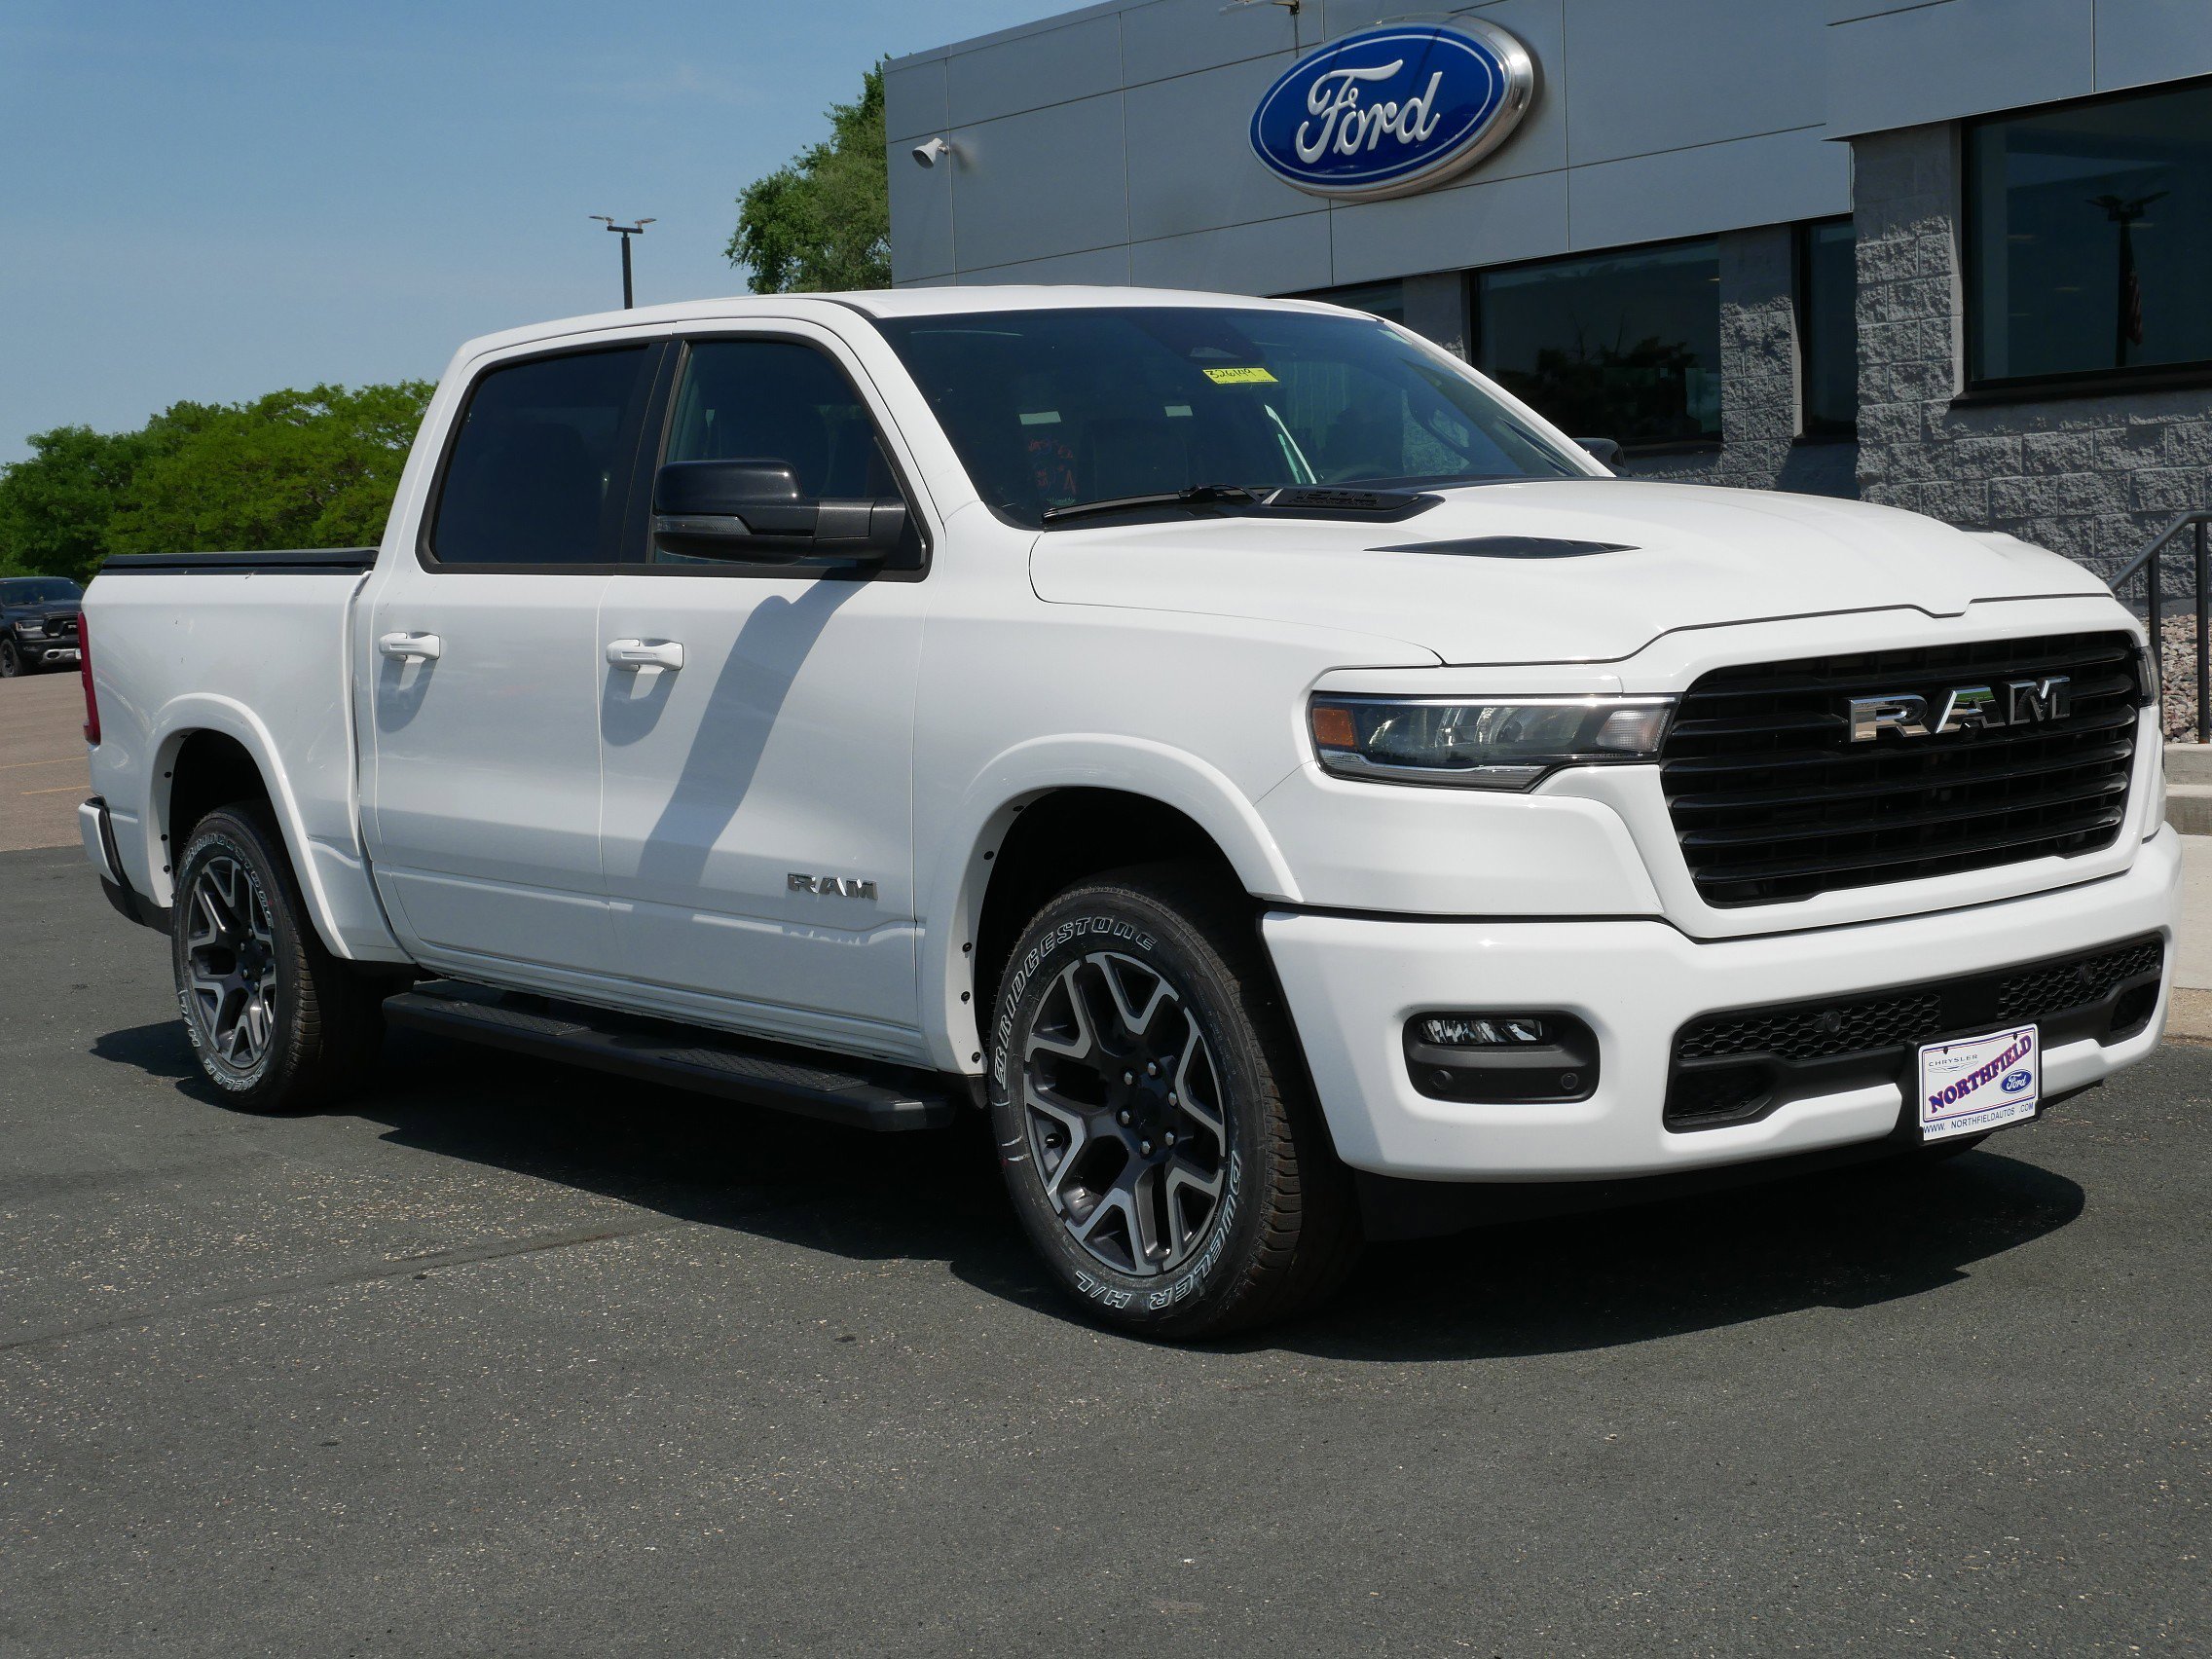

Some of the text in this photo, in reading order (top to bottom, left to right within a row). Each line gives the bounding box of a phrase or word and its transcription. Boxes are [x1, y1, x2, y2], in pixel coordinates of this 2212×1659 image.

[1295, 58, 1444, 165] Ford
[1850, 676, 2071, 743] RAM
[787, 871, 879, 902] RAM
[994, 915, 1160, 1091] BRIDGESTONE
[1928, 1053, 1978, 1067] CHRYSLER
[1928, 1035, 2033, 1114] NORTHFIELD
[2006, 1072, 2027, 1090] Ford
[1950, 1107, 2015, 1129] NORTHFIELDAUTOS
[1075, 1150, 1243, 1310] DUELER H/L
